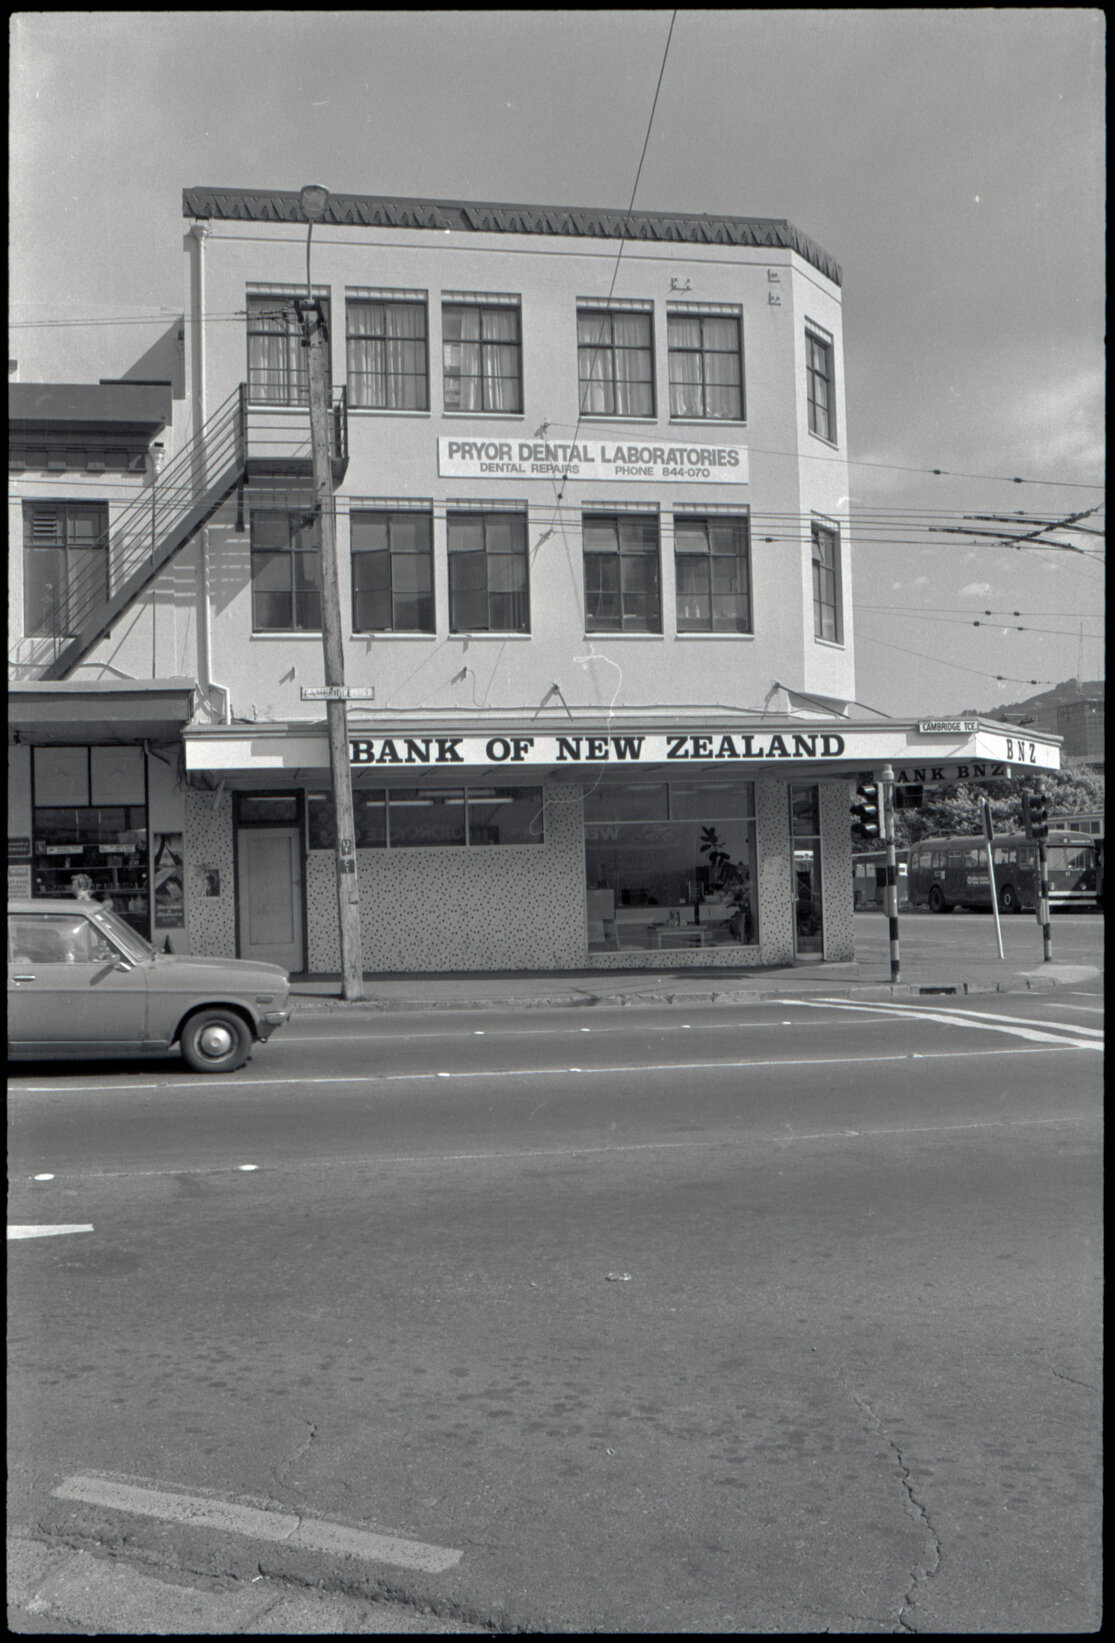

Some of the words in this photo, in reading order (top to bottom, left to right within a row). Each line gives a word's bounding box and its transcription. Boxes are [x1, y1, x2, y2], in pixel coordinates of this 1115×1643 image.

[447, 441, 513, 462] PRYOR
[518, 443, 595, 463] DENTAL
[601, 445, 740, 467] LABORATORIES
[480, 462, 526, 473] DENTAL
[530, 463, 580, 475] REPAIRS
[615, 466, 654, 476] PHONE
[922, 722, 961, 732] CAMBRIDGE
[963, 722, 977, 732] TCE
[350, 738, 464, 764] BANK
[486, 737, 534, 762] OF
[556, 736, 646, 761] NEW
[667, 733, 846, 760] ZEALAND
[1005, 738, 1037, 764] BNZ
[896, 767, 946, 783] ANK
[956, 763, 1005, 780] BNZ
